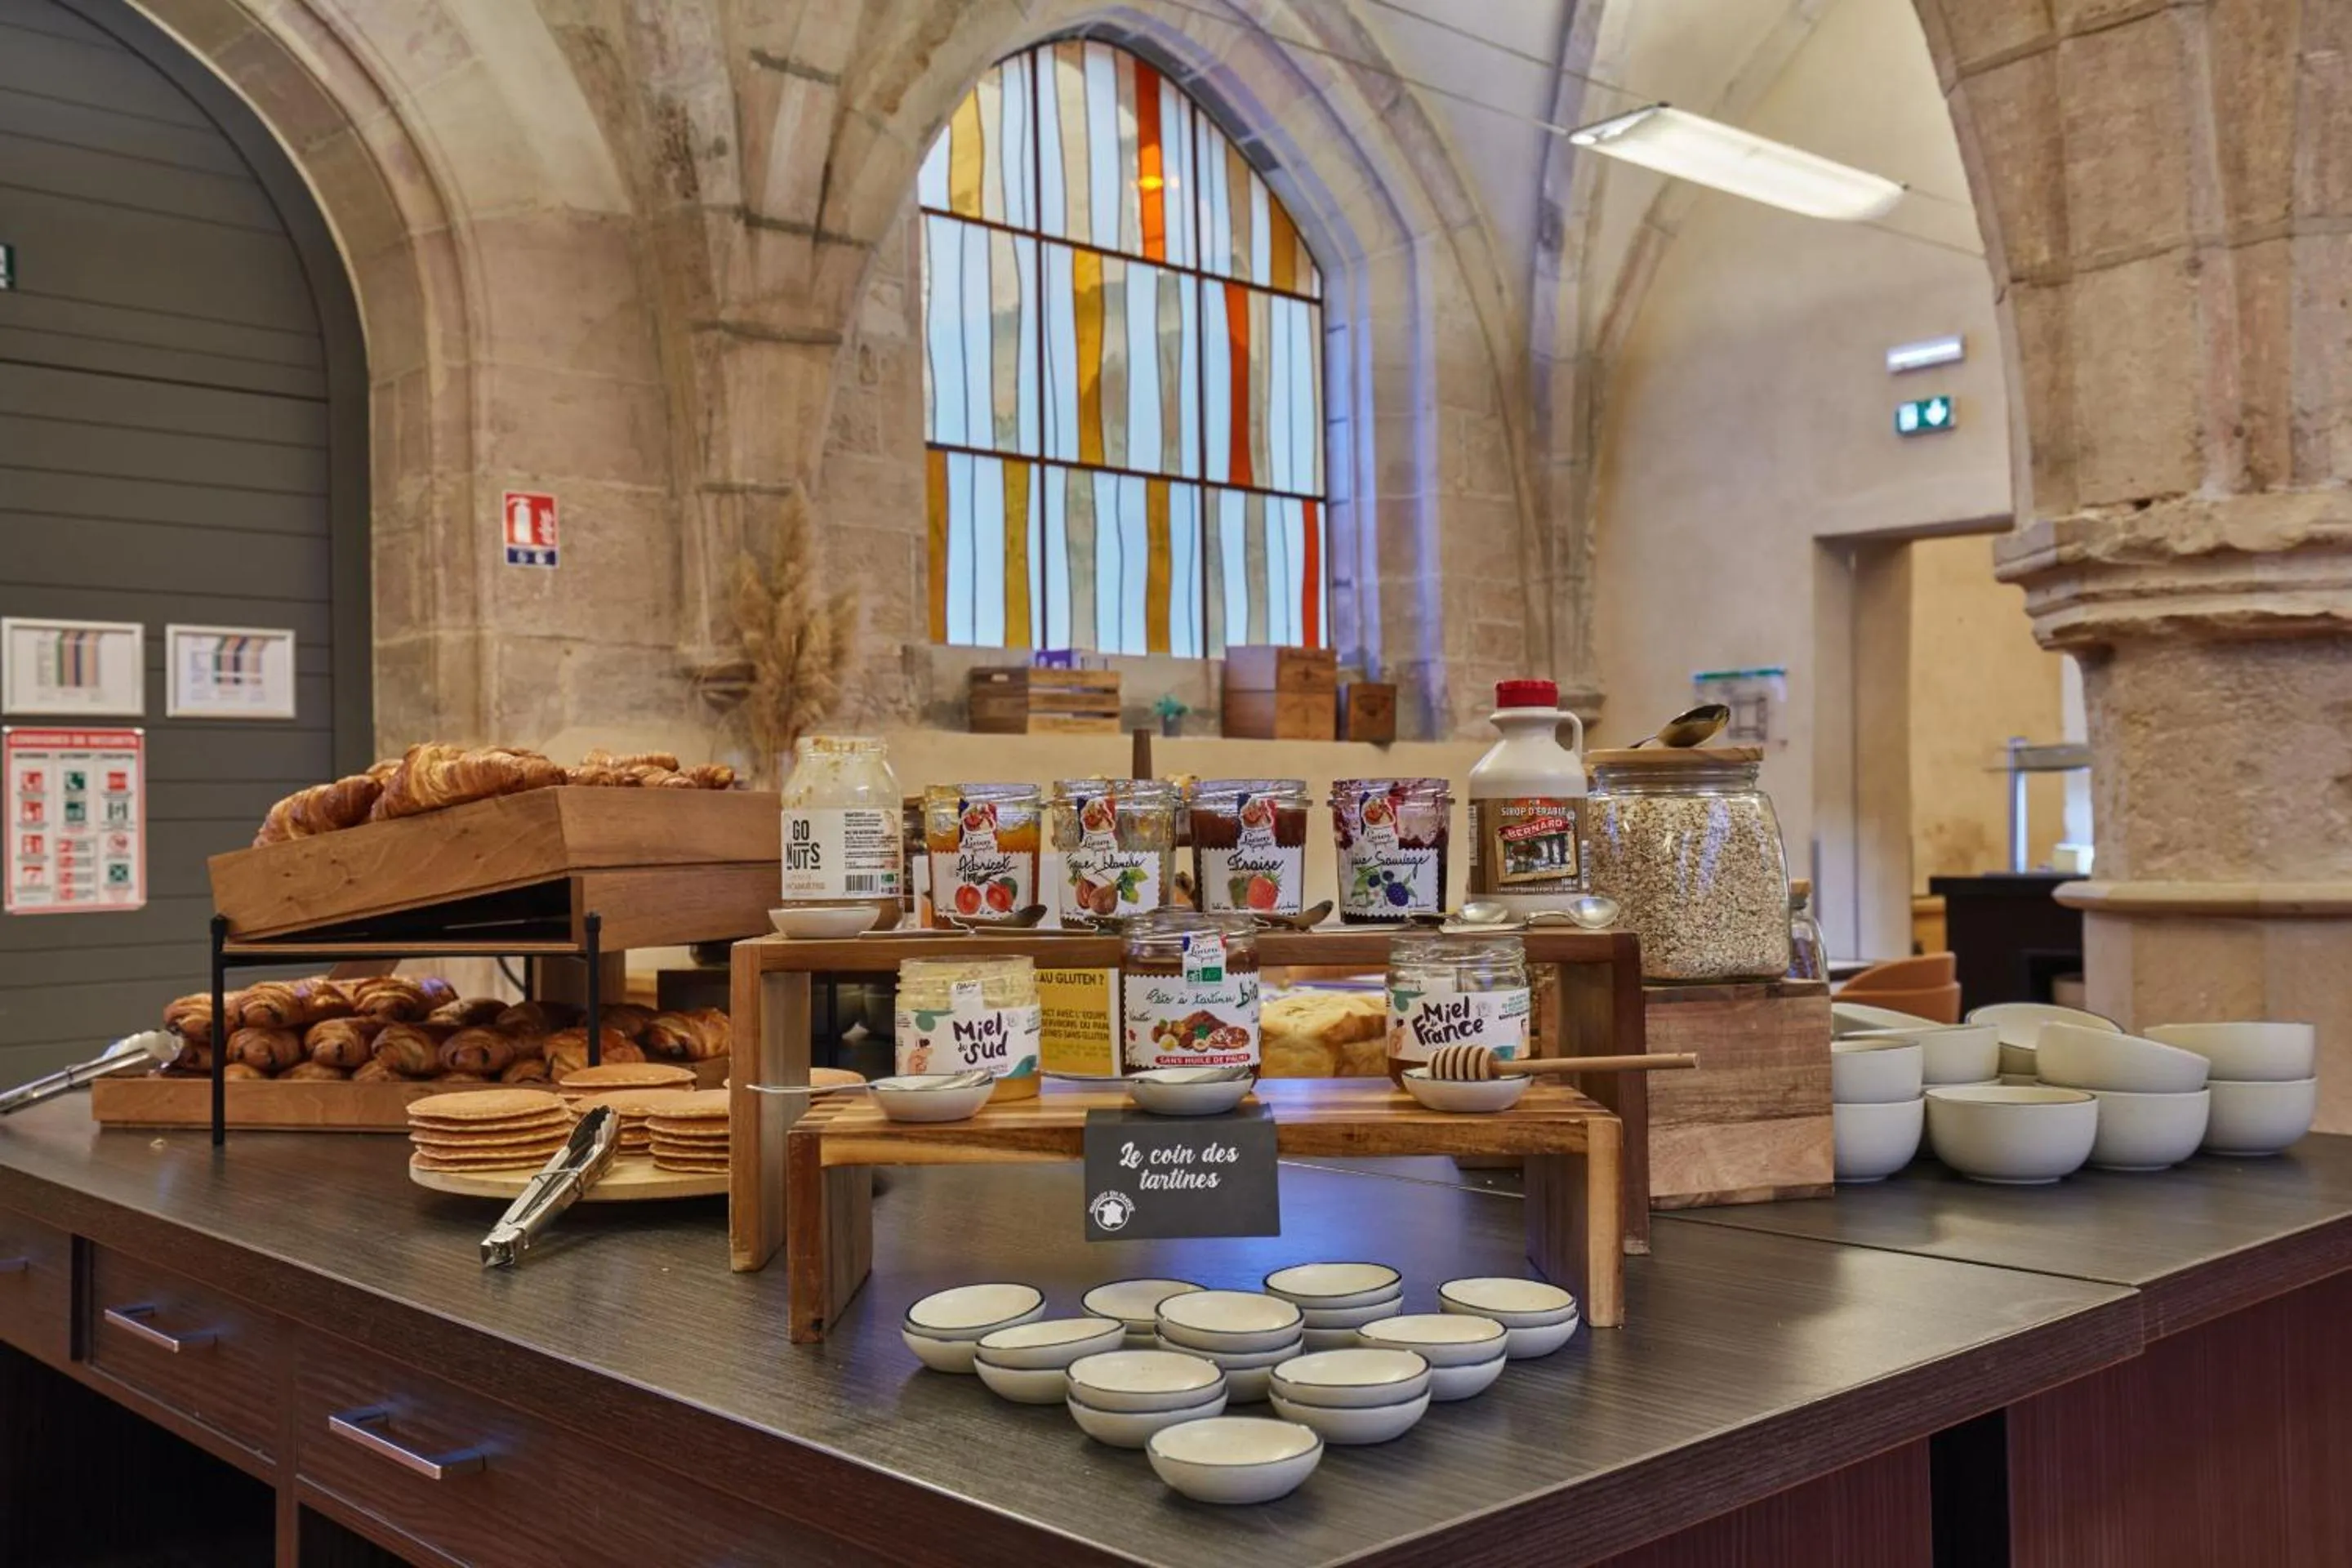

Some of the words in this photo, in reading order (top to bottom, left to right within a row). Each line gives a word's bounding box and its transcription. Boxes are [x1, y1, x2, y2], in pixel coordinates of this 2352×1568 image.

[1501, 807, 1526, 816] SIROP
[793, 820, 809, 840] GO
[1508, 819, 1562, 838] BERNARD
[786, 842, 821, 870] NUTS
[1227, 850, 1284, 871] Fraise
[1040, 973, 1053, 983] AU
[1055, 973, 1095, 985] GLUTEN
[1098, 975, 1104, 985] ?
[1236, 982, 1258, 1008] bio
[1422, 996, 1470, 1022] Miel
[953, 1011, 1002, 1042] Miel
[1412, 1014, 1484, 1046] France
[1119, 1141, 1143, 1169] Le
[1150, 1143, 1195, 1165] coin
[1201, 1142, 1239, 1163] des
[1139, 1169, 1221, 1191] tartines
